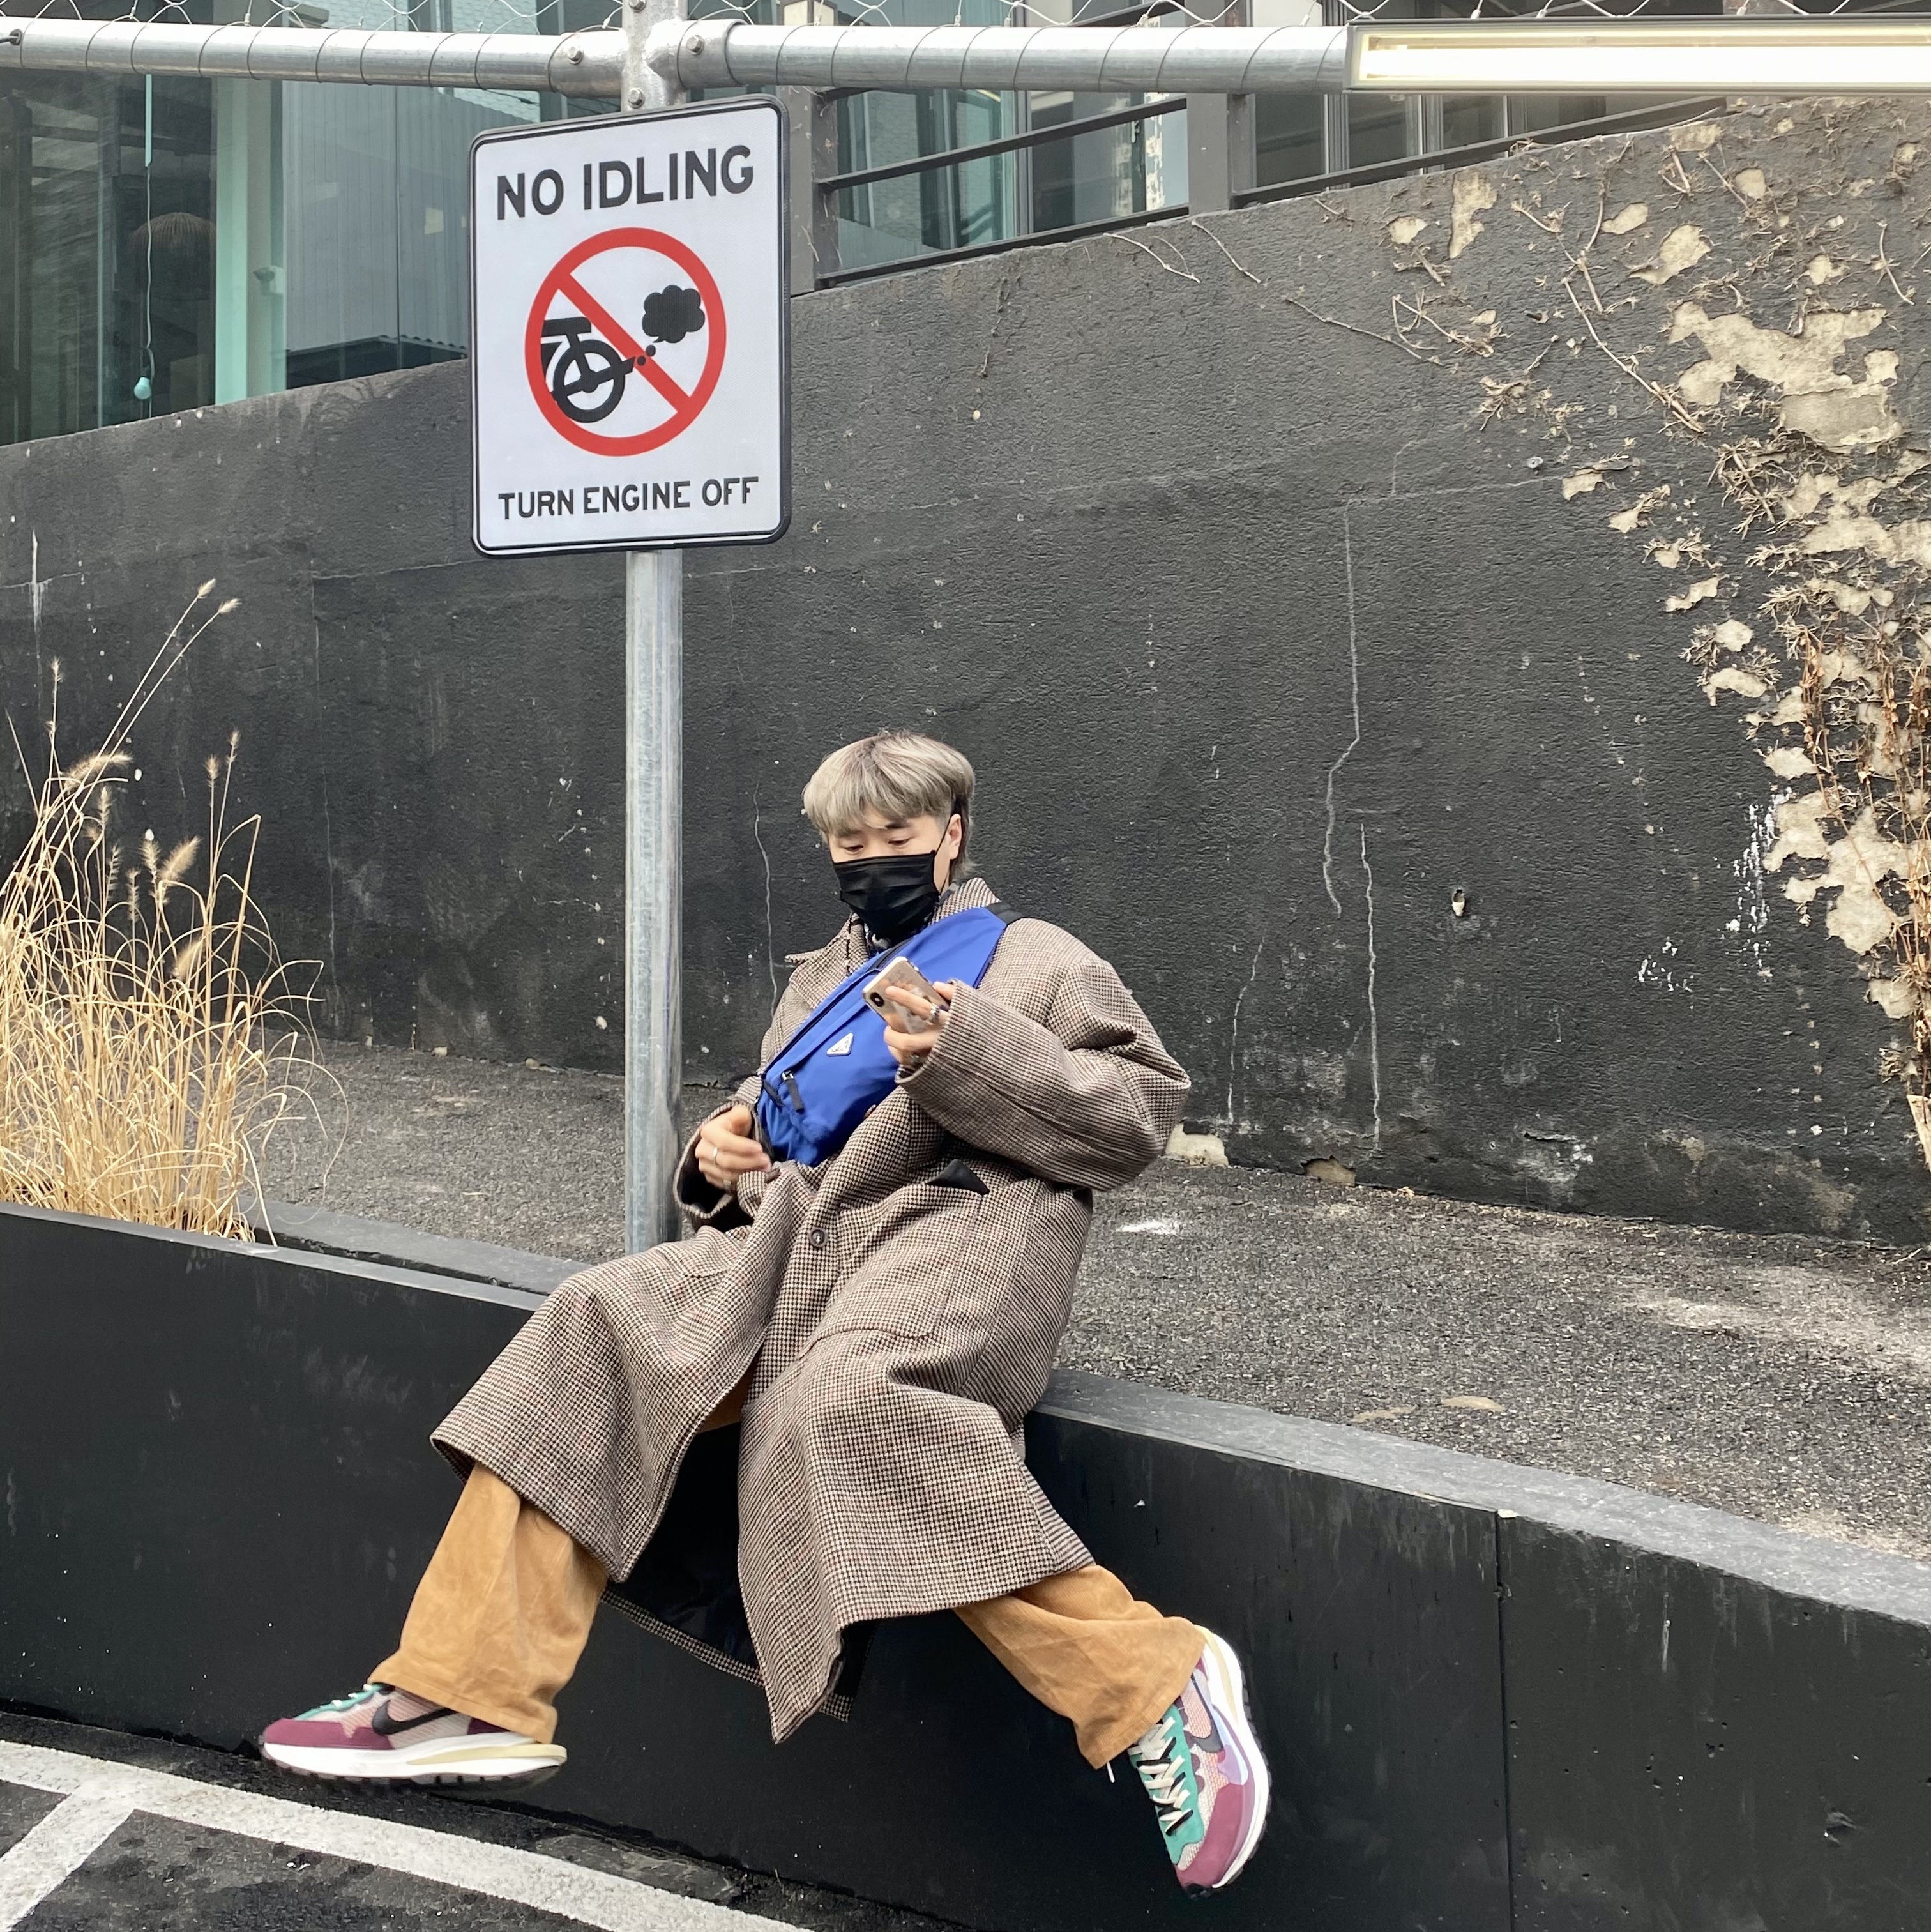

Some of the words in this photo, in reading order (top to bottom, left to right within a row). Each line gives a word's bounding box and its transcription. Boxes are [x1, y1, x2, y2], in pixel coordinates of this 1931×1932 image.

[497, 168, 564, 221] NO
[583, 144, 755, 211] IDLING
[498, 488, 575, 521] TURN
[583, 480, 691, 515] ENGINE
[701, 476, 759, 507] OFF
